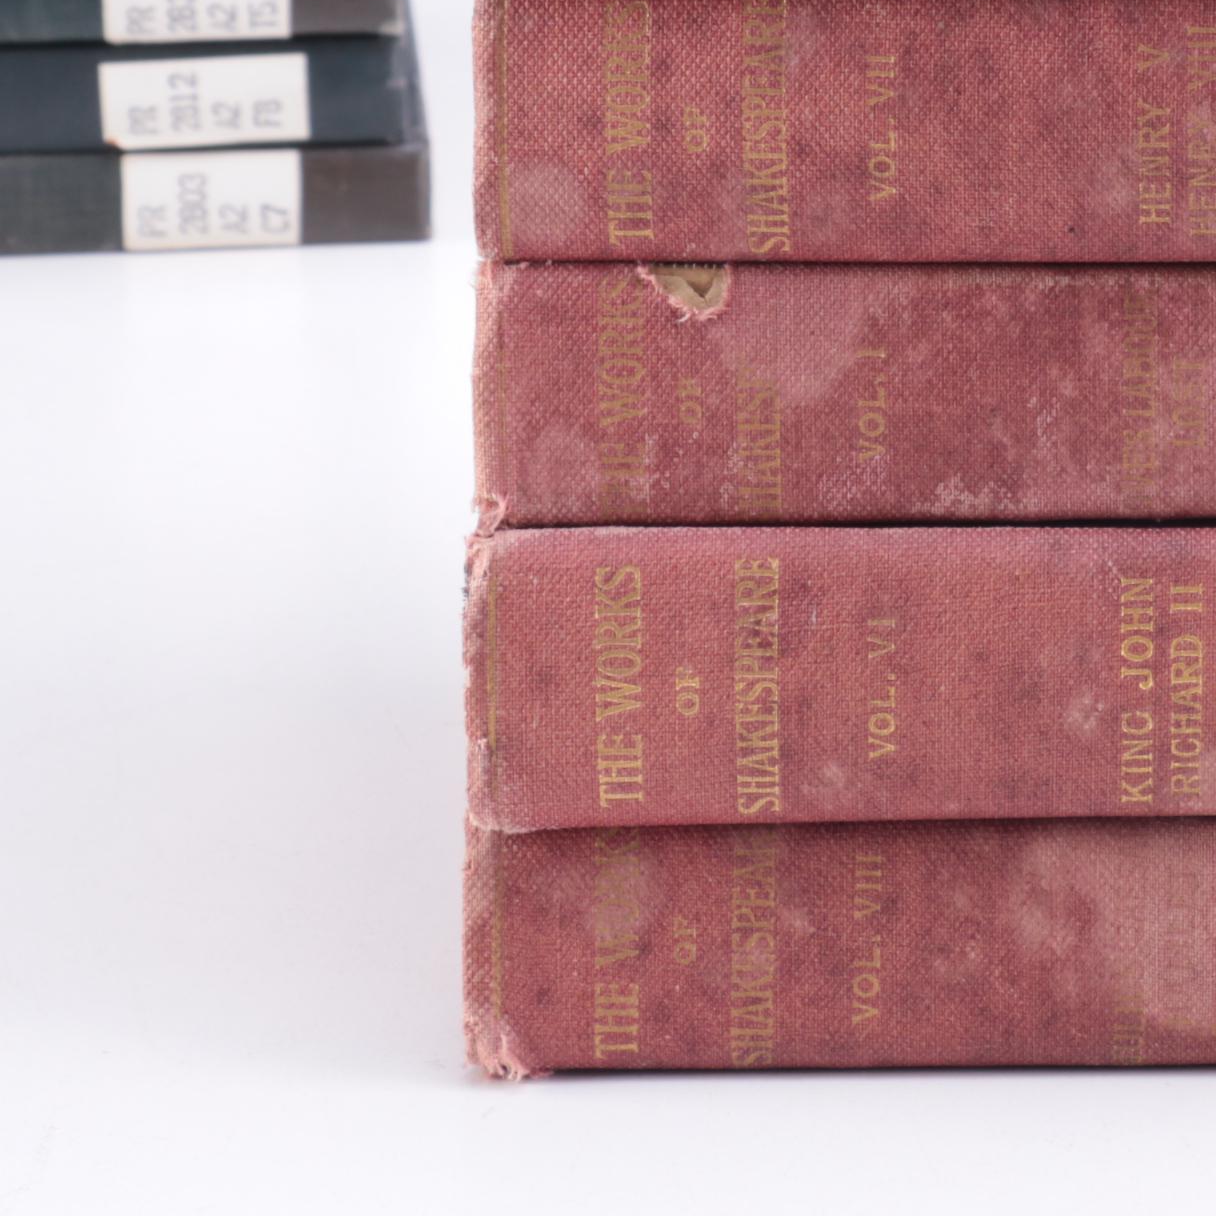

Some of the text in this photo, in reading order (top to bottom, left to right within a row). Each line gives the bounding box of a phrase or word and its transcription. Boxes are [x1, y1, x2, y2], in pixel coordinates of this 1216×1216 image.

[123, 5, 158, 36] PR
[602, 0, 655, 247] THE WORKS
[683, 104, 709, 154] OF
[863, 53, 897, 202] VOL. VII
[1136, 42, 1172, 225] HENRY V
[136, 204, 169, 239] PR
[258, 203, 292, 234] C7
[596, 276, 647, 429] WORKS
[677, 375, 705, 425] OF
[858, 346, 890, 463] VOL. I
[1170, 355, 1208, 450] LOST
[591, 562, 645, 808] THE WORKS
[675, 665, 701, 718] OF
[735, 556, 781, 816] SHAKESPEARE
[866, 616, 897, 760] VOL. VI
[1119, 576, 1155, 805] KING JOHN
[1168, 582, 1204, 796] RICHARD II
[672, 915, 698, 966] OF
[851, 852, 883, 1025] VOL. VIII
[591, 982, 641, 1061] THE
